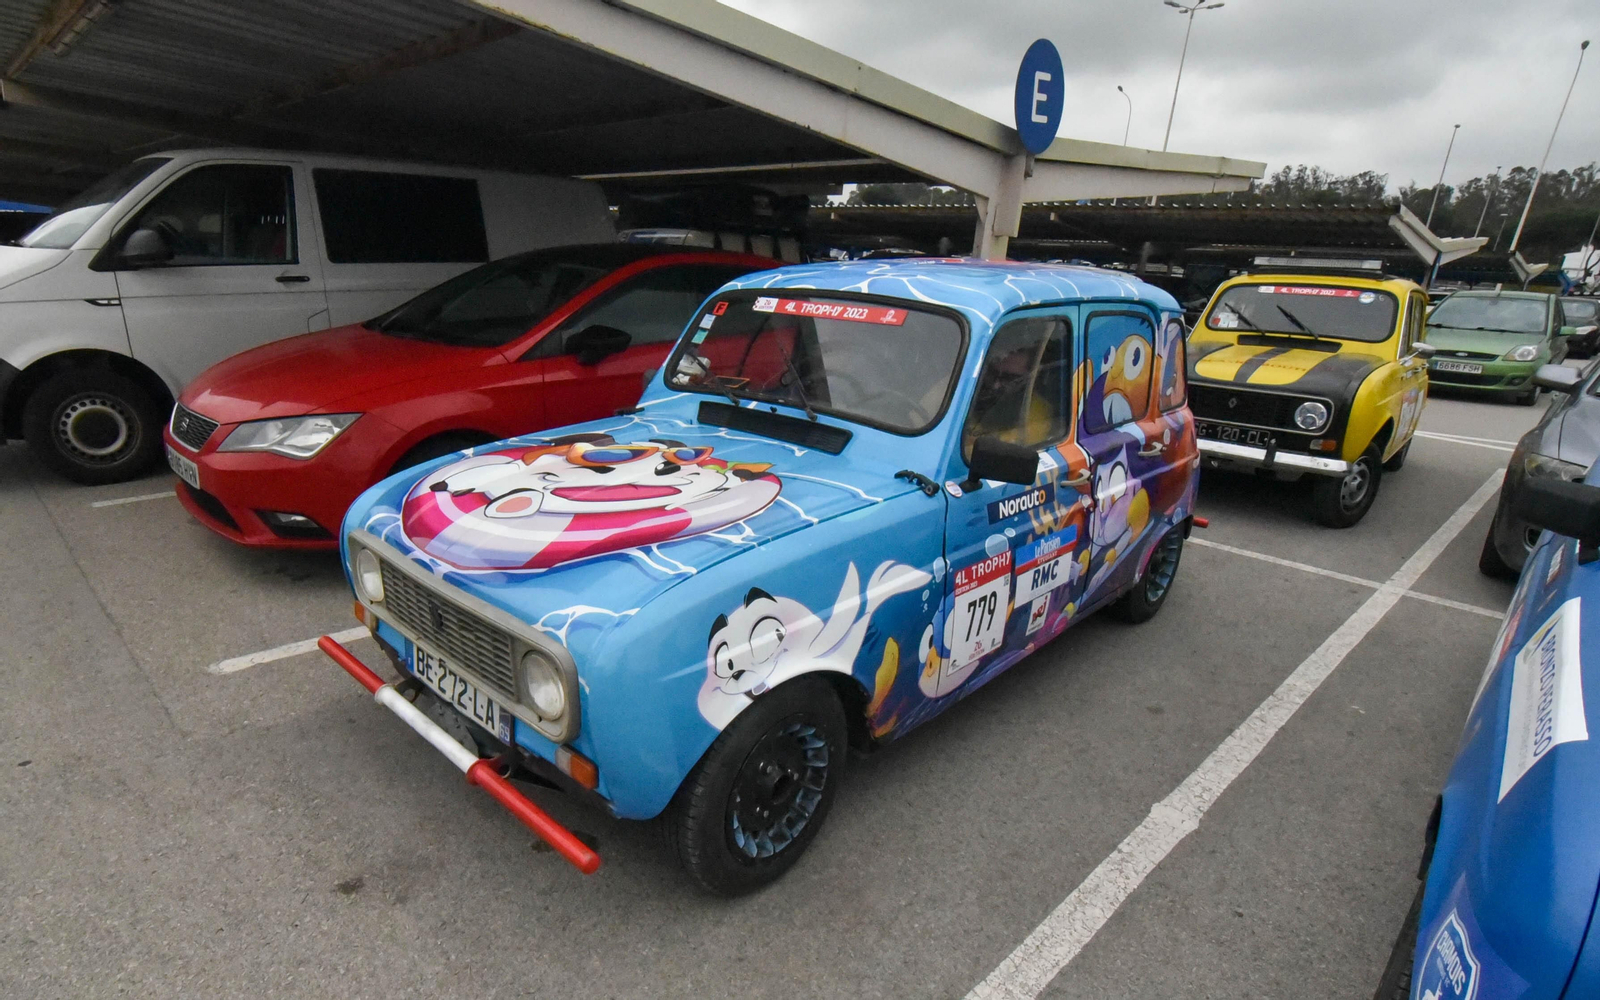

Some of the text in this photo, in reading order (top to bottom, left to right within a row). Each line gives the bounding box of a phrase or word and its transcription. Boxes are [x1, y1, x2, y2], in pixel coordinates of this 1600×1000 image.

[1031, 70, 1052, 124] E
[1291, 287, 1319, 295] TROPHY
[716, 303, 724, 313] F
[785, 301, 797, 312] 4L
[800, 303, 844, 317] TROPHY
[843, 306, 869, 319] 2023
[999, 489, 1047, 519] Norauto
[955, 550, 1011, 586] 4L TROPHY
[1031, 559, 1060, 591] RMC
[965, 590, 998, 642] 779
[1533, 634, 1556, 757] BRONZO PERASSO
[499, 722, 510, 742] 69
[1436, 930, 1466, 996] CHAMOIS
